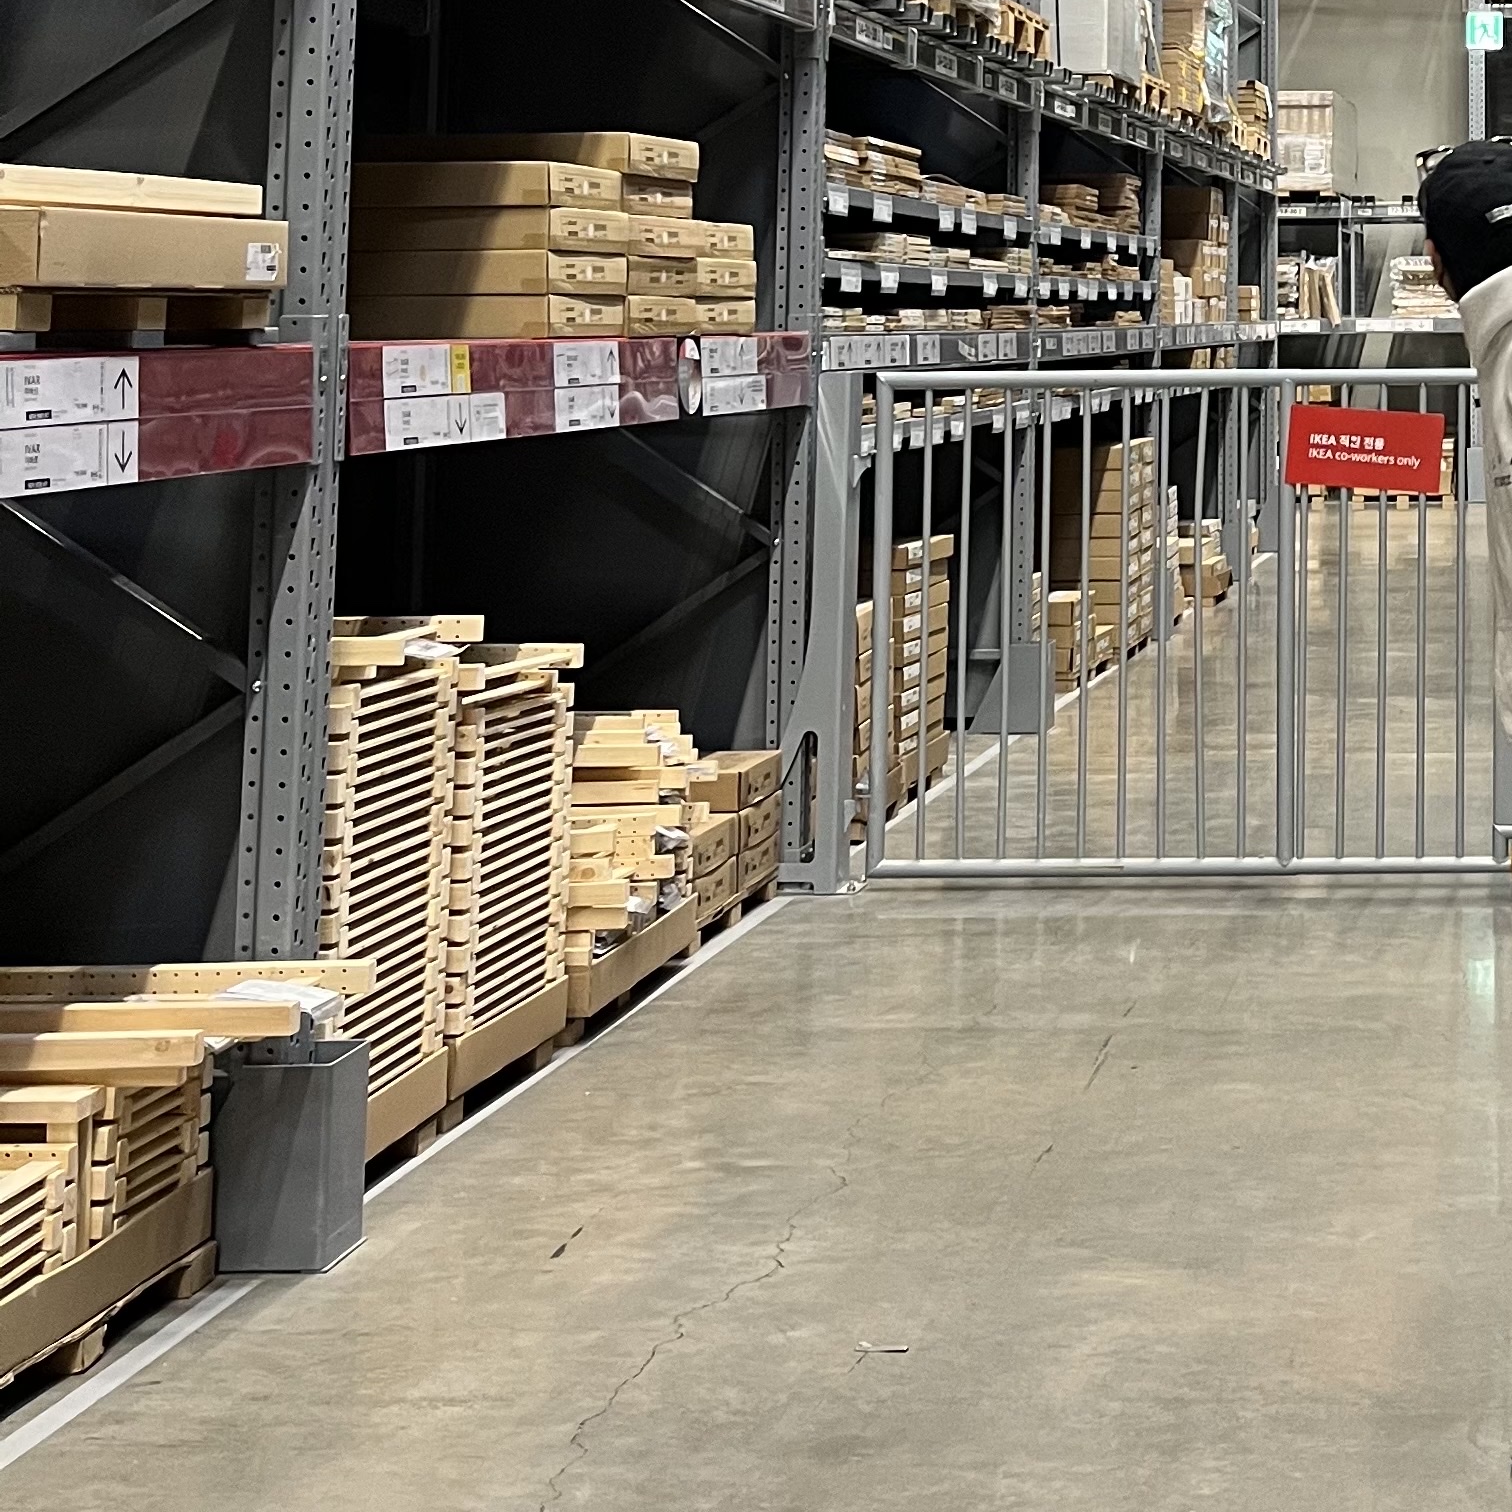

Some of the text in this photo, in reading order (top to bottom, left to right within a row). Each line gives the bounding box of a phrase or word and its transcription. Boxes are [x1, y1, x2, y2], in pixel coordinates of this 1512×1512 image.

[1309, 433, 1337, 446] IKEA
[1308, 447, 1421, 470] IKEA co-workers only
